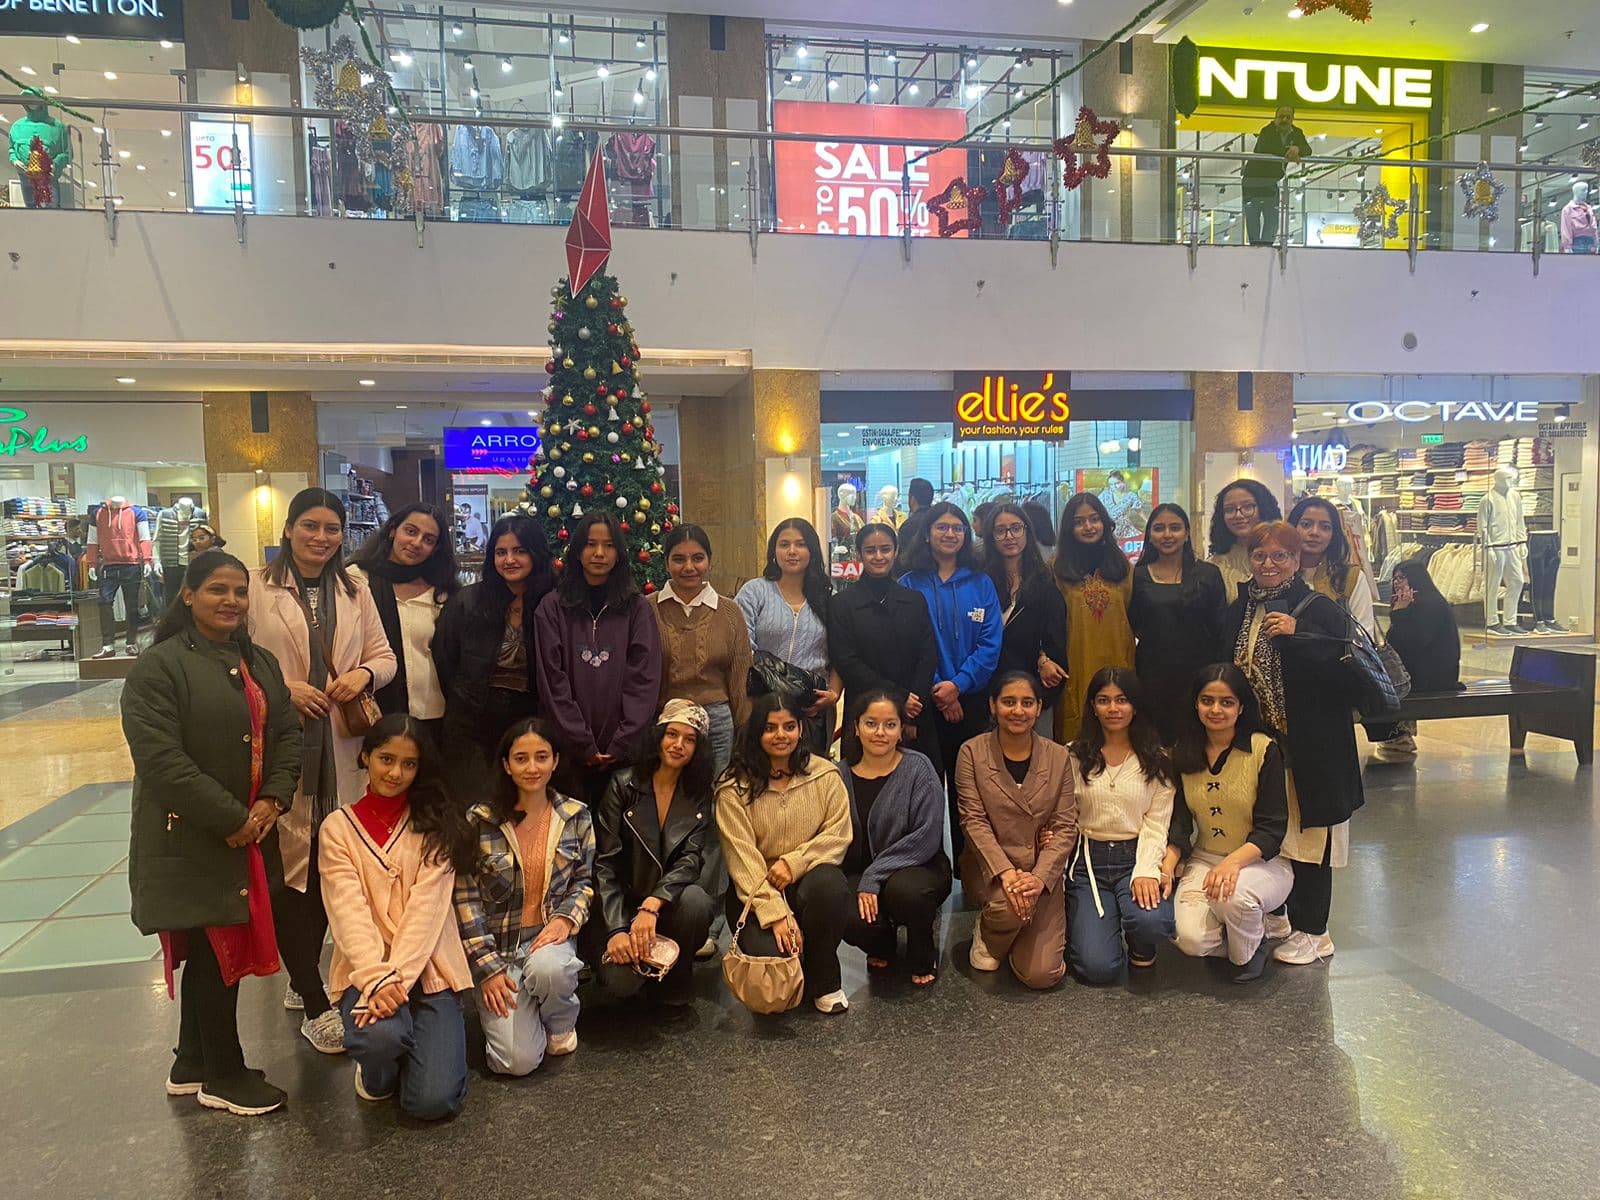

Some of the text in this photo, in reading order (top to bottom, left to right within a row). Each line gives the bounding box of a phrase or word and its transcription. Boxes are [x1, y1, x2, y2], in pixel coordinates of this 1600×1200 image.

[1198, 56, 1433, 108] NTUNE
[195, 145, 235, 171] 50
[814, 142, 931, 182] SALE
[838, 185, 931, 236] 50%
[956, 370, 1071, 423] ellie's
[1348, 401, 1539, 422] OCTAVE
[471, 434, 537, 447] ARRO
[861, 437, 921, 446] ENVOKE ASSOCIATES
[960, 425, 1064, 436] your fashion, your rules
